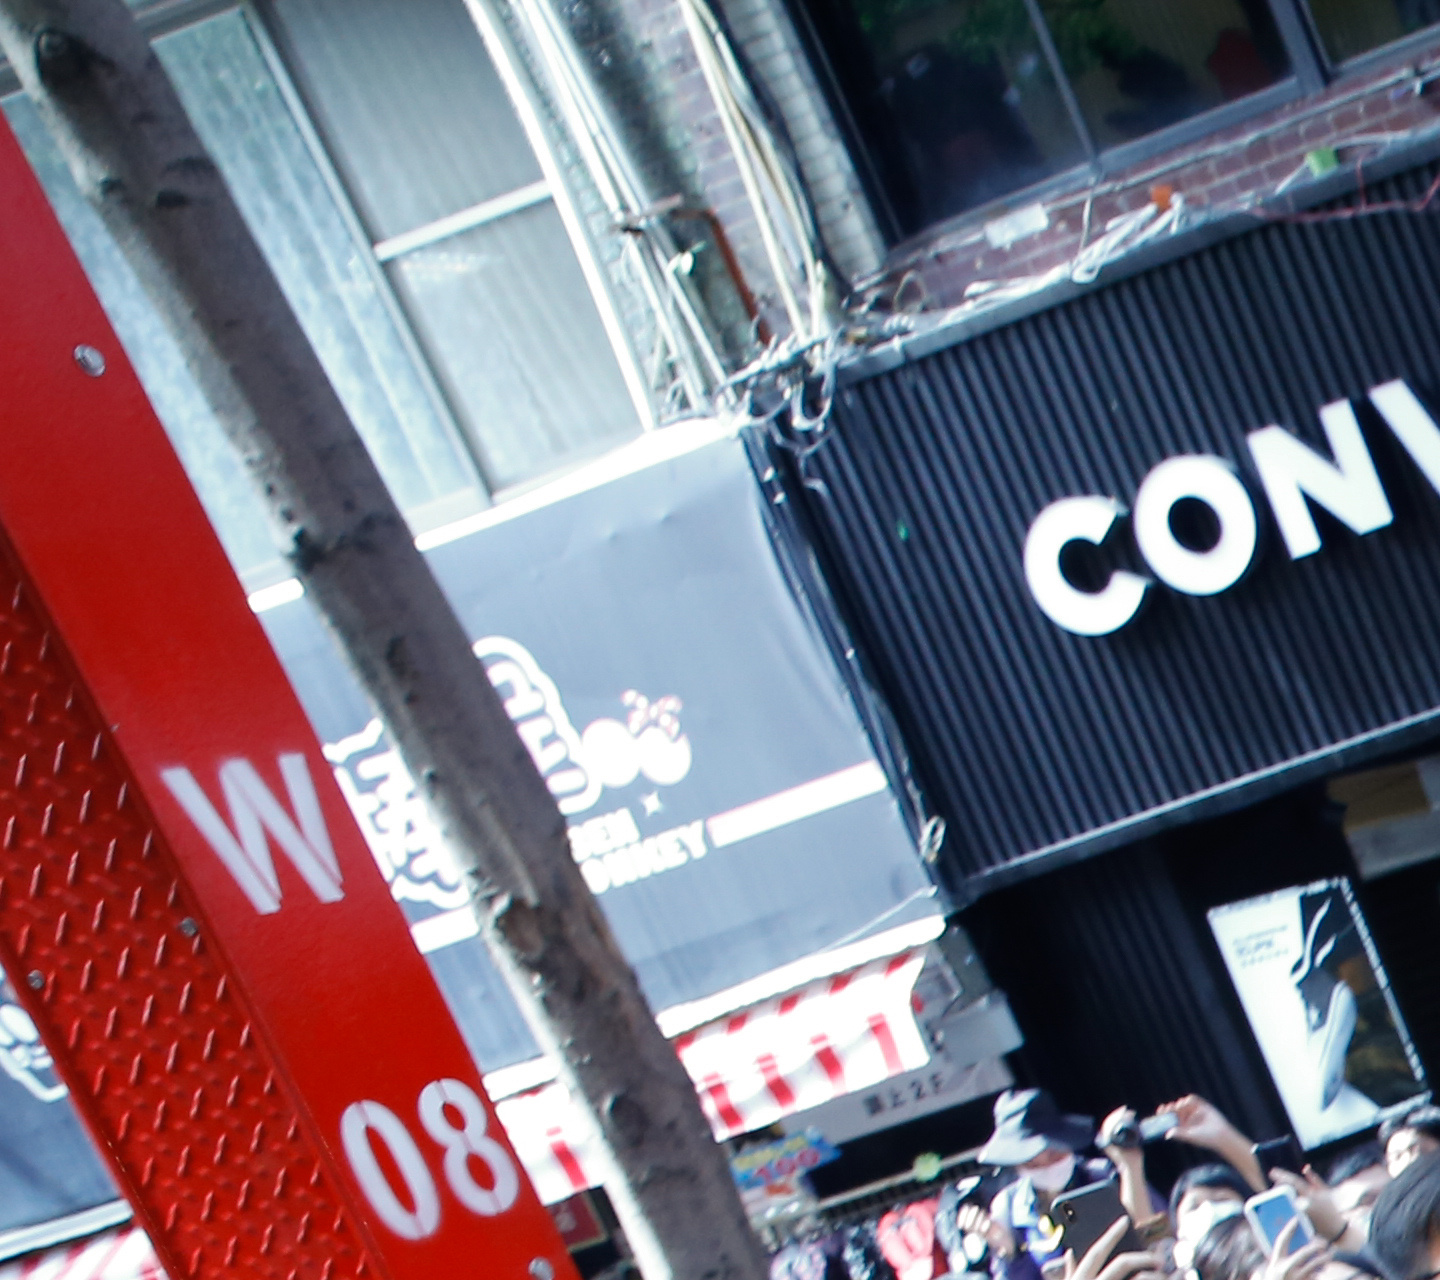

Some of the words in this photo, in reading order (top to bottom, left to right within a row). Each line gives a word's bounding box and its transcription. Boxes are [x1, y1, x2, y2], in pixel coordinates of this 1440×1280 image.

[160, 752, 346, 915] W
[579, 818, 709, 895] ONKEY
[340, 1077, 520, 1242] 08
